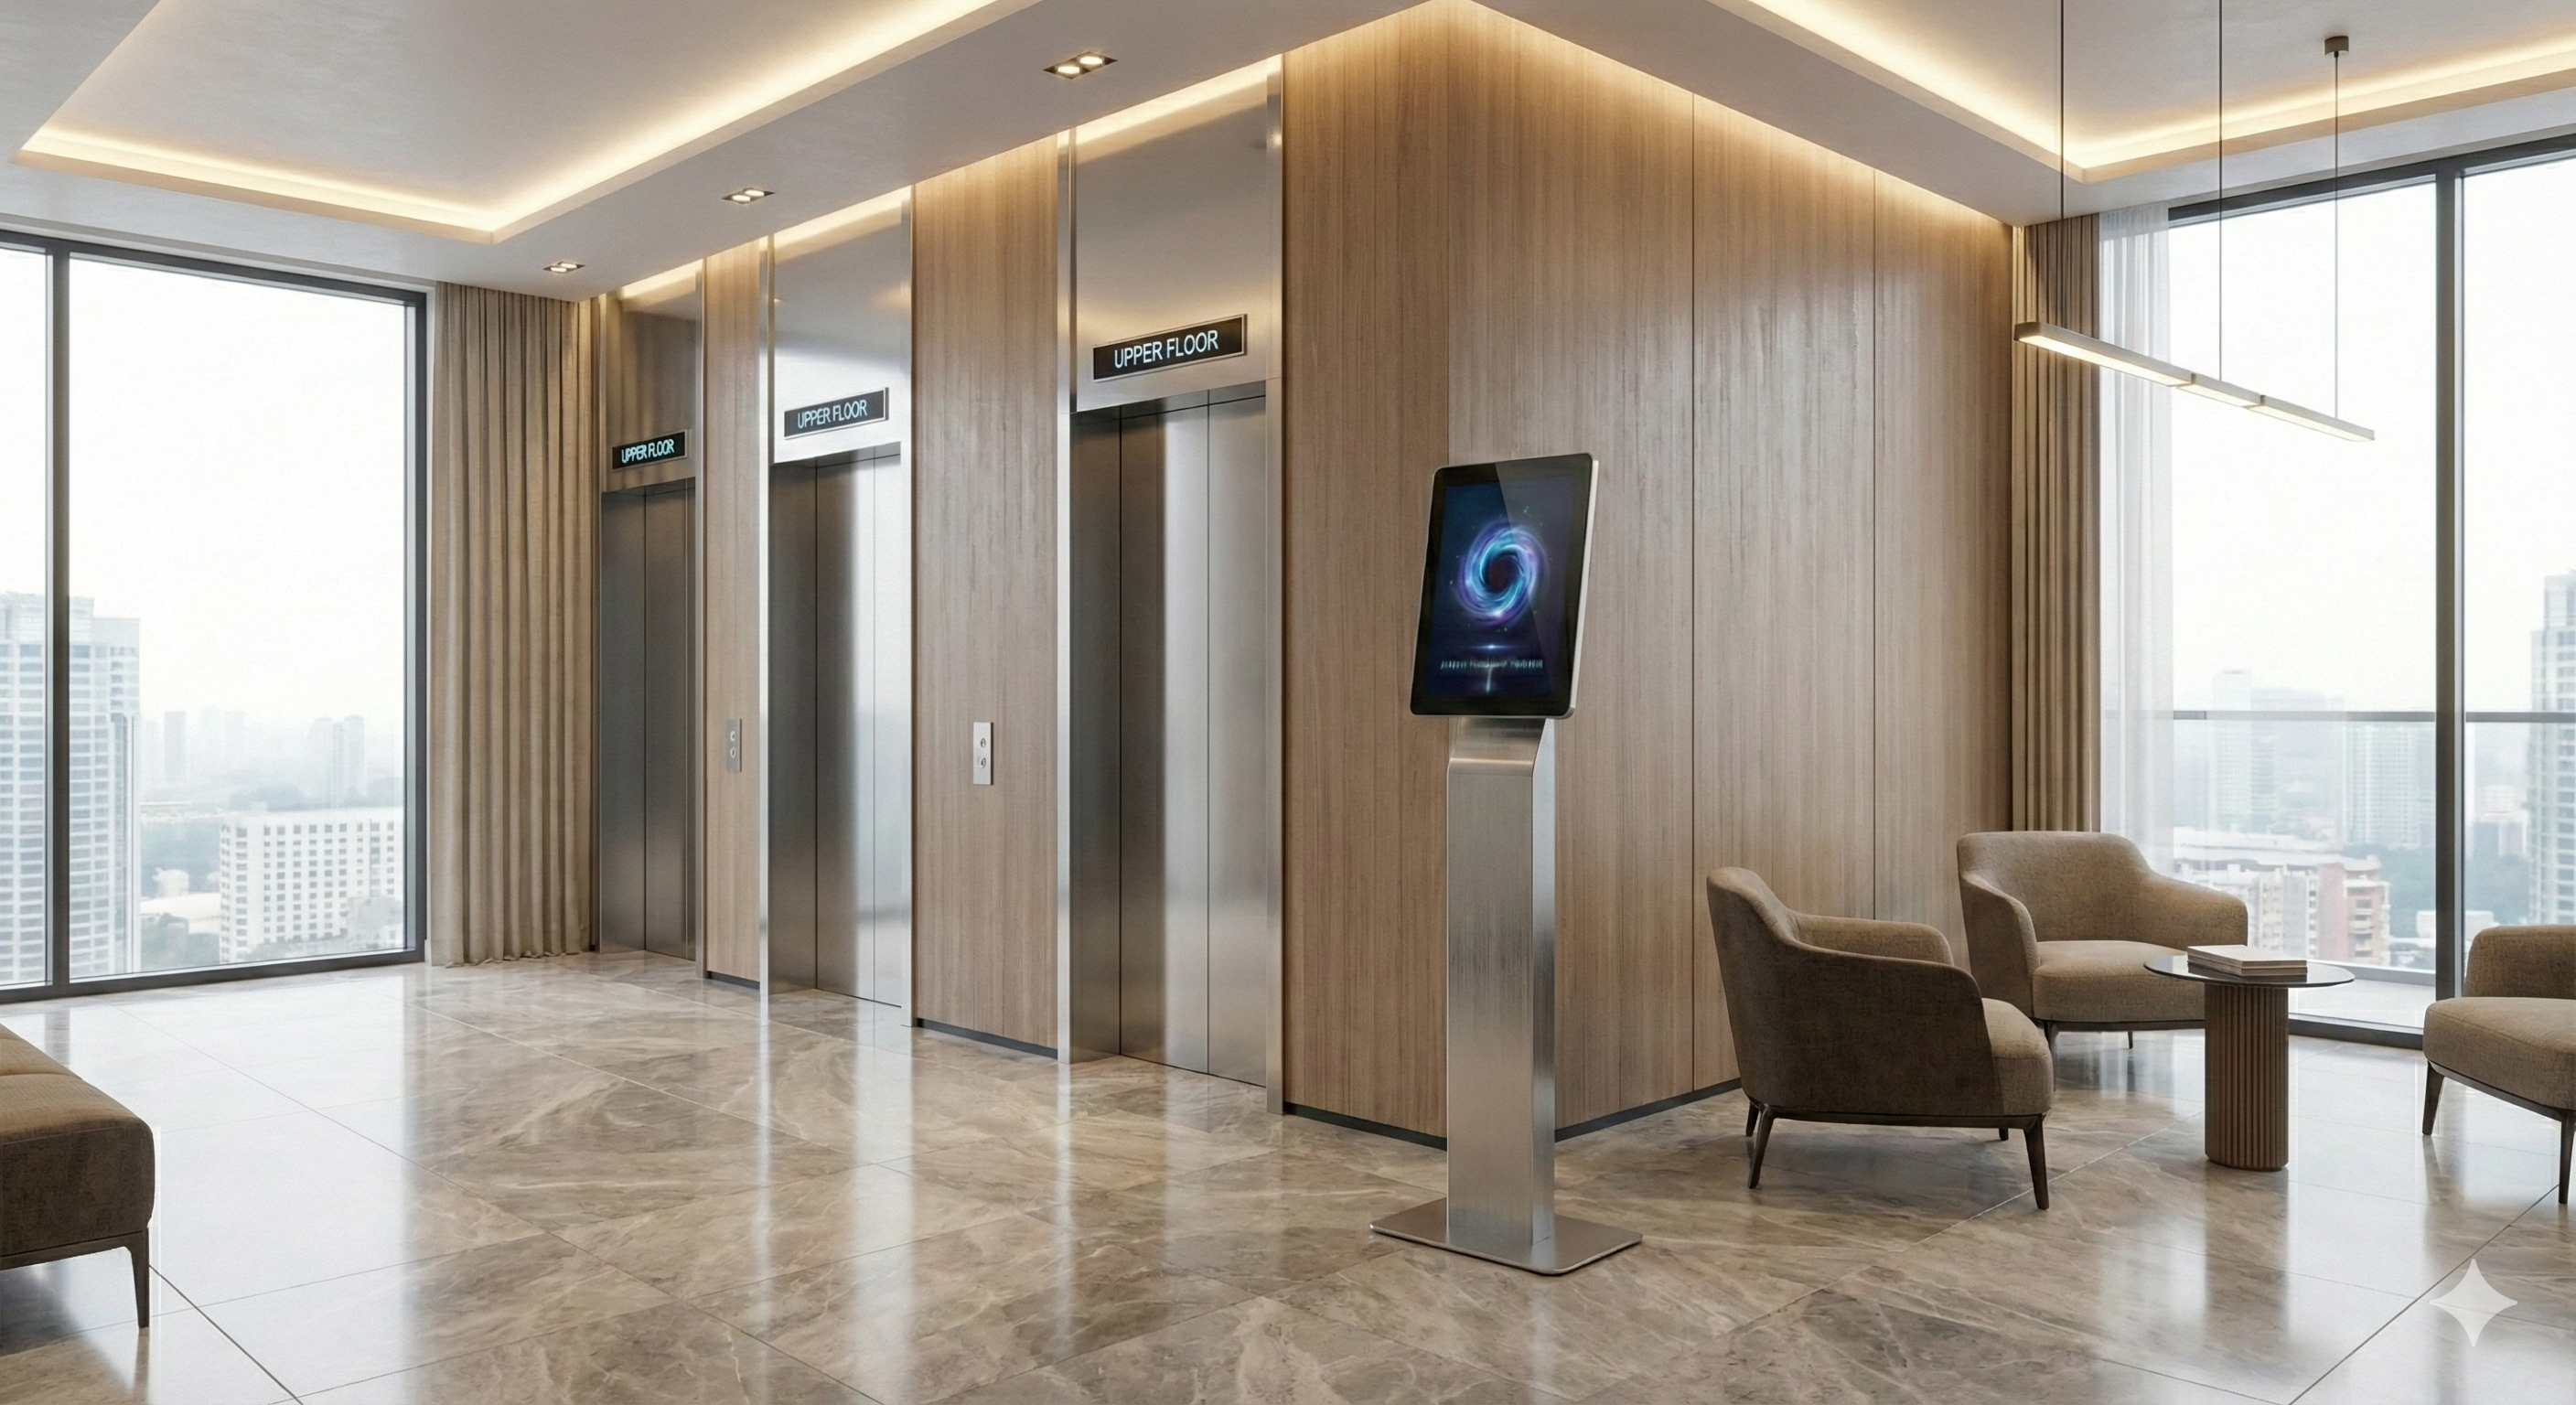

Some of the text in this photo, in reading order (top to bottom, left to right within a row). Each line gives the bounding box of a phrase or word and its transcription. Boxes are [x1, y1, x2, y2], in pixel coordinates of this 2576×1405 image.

[1114, 329, 1219, 369] UPPER FLOOR
[797, 399, 868, 429] UPPER FLOOR
[621, 438, 675, 464] UPPER FLOOR
